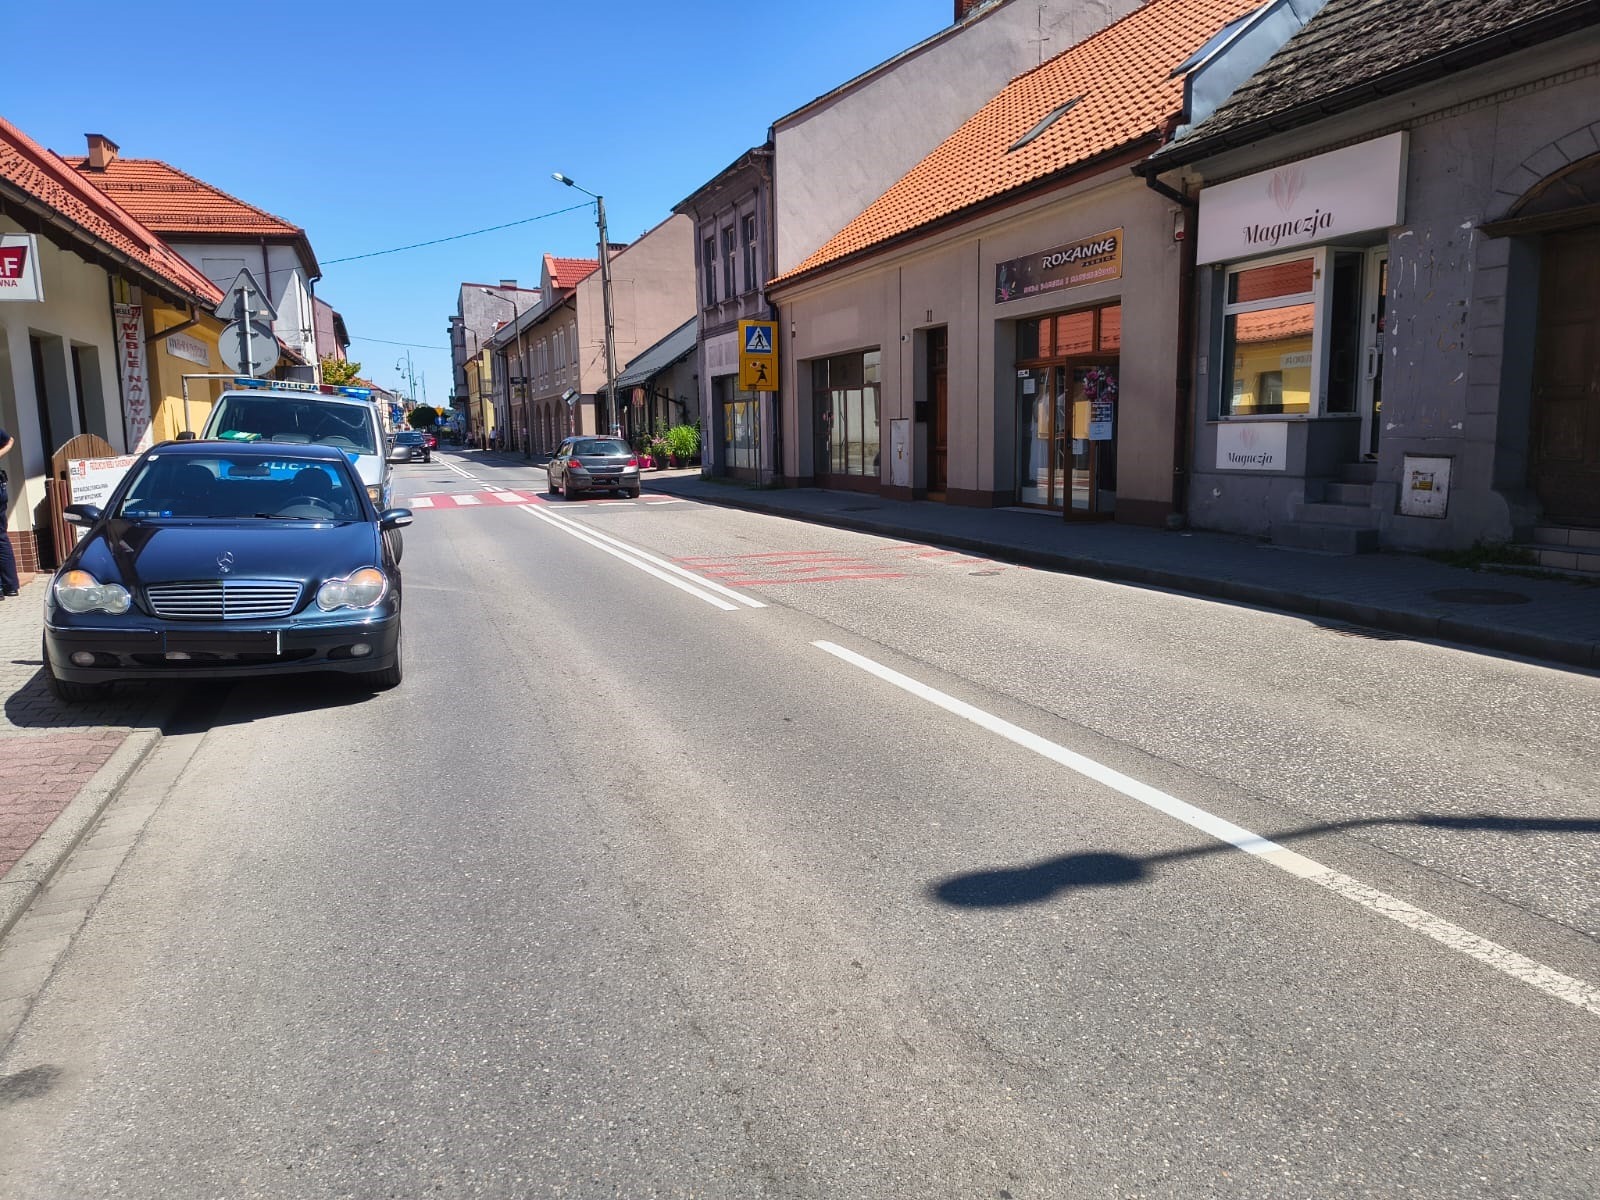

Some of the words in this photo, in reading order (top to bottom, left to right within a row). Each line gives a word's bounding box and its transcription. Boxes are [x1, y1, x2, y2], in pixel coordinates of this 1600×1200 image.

[1243, 208, 1335, 246] Magnezja
[1042, 237, 1115, 269] ROXANNE
[123, 323, 141, 368] MEBLE
[127, 375, 142, 393] NA
[272, 381, 319, 391] POLICJA
[1226, 452, 1273, 467] Magnezja
